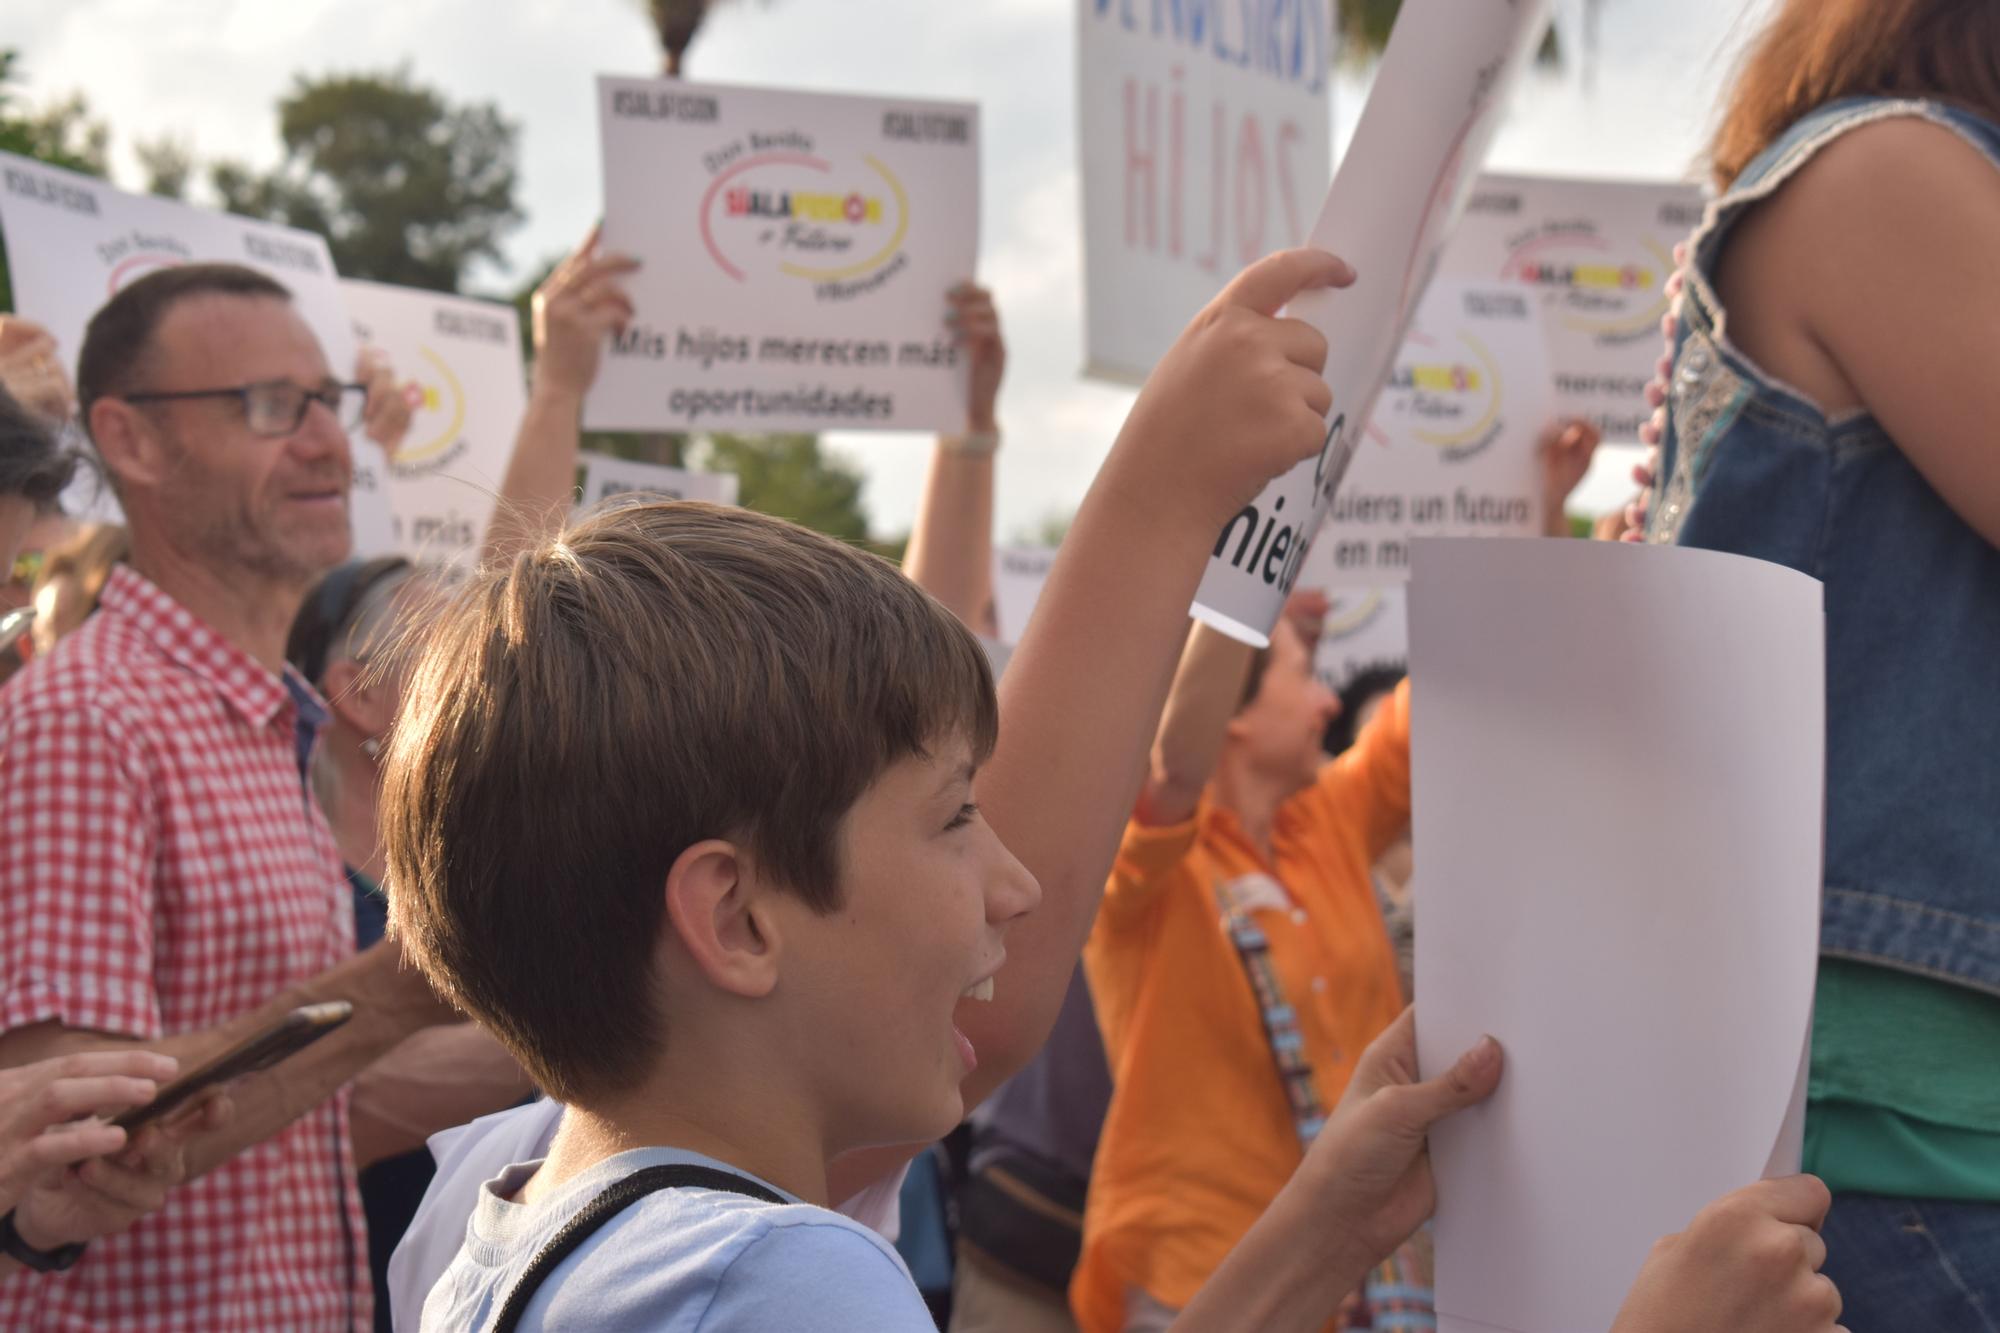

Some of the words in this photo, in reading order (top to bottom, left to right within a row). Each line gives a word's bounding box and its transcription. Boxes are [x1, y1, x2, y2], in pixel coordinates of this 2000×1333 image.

[611, 328, 665, 359] Mis
[674, 327, 749, 371] hijos
[758, 335, 891, 366] merecen
[897, 336, 959, 367] más
[667, 382, 894, 422] oportunidades
[1332, 484, 1404, 524] uiero
[1410, 492, 1446, 524] un
[1453, 485, 1531, 525] futuro
[1334, 540, 1370, 571] en
